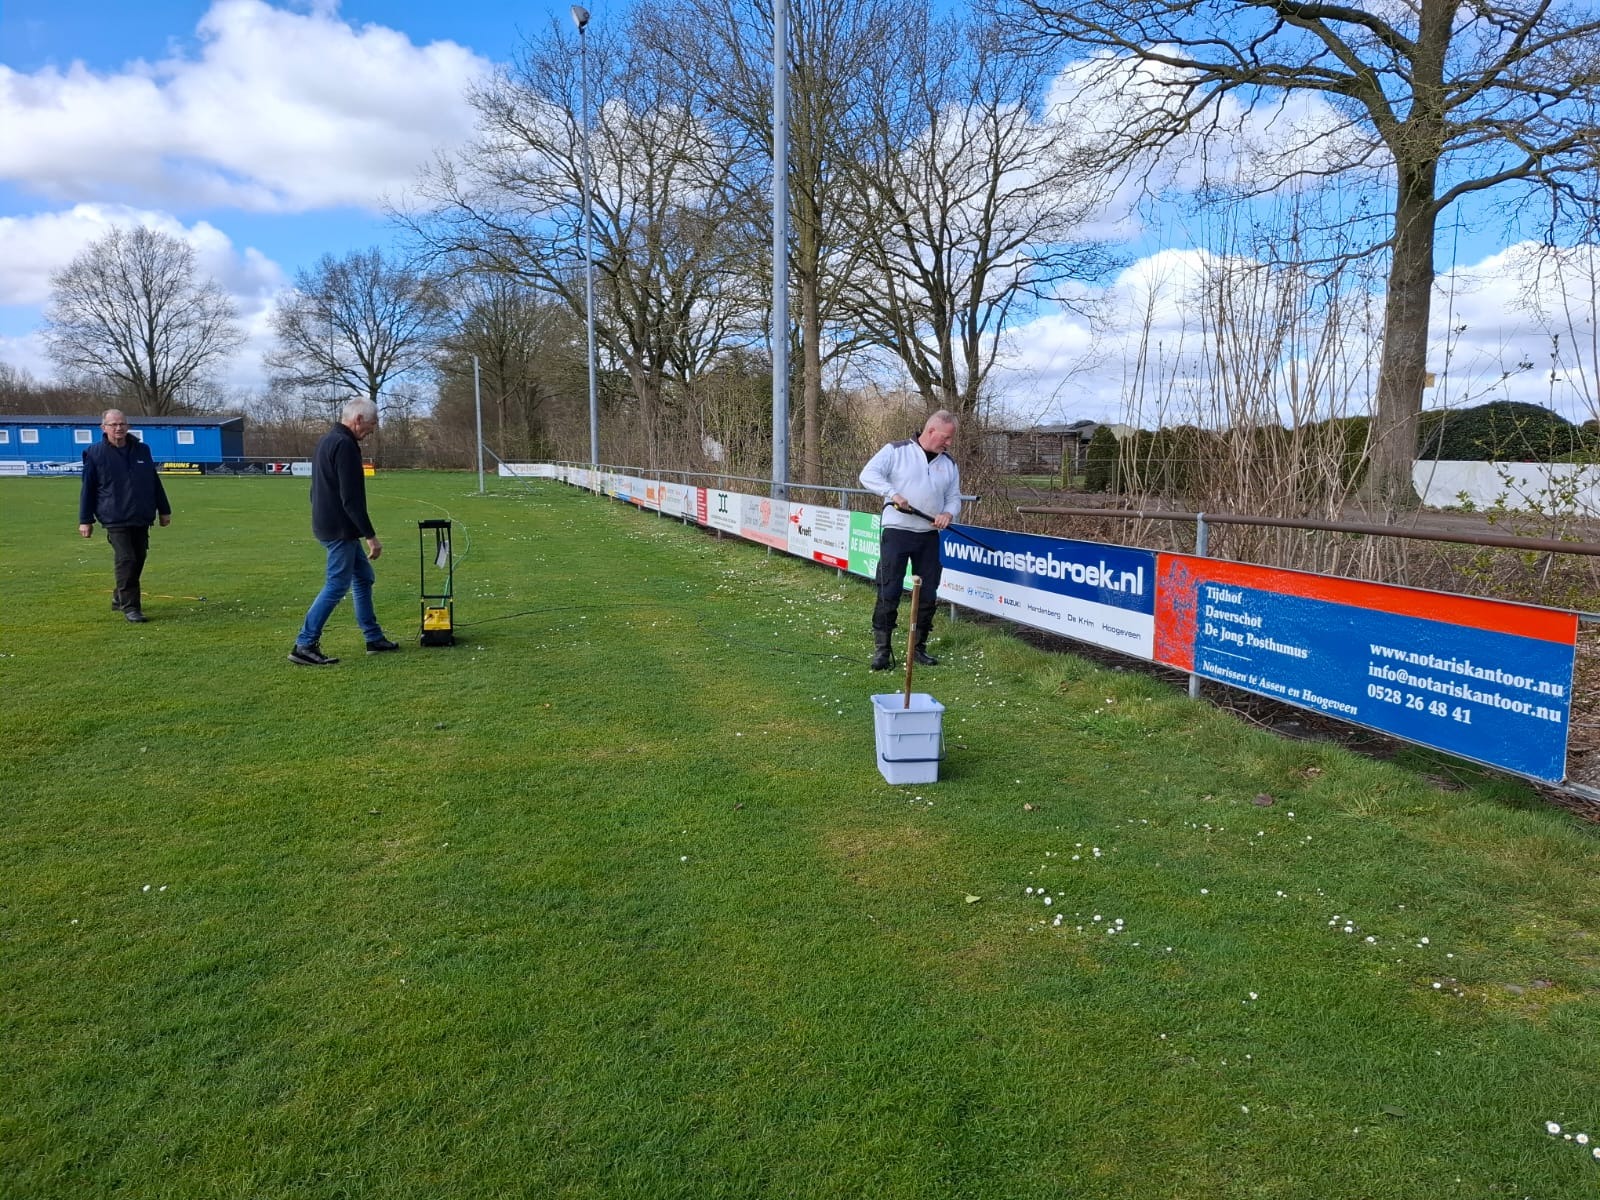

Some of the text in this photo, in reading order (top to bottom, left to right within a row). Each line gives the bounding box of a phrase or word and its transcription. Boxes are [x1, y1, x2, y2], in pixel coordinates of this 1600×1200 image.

[944, 540, 1143, 595] www.mastebroek.nl
[1027, 603, 1061, 620] Hardenberg
[1205, 586, 1243, 604] Tijdhof
[1067, 613, 1094, 628] De Krim
[1102, 622, 1141, 640] Hoogeveen
[1205, 605, 1263, 628] Daverschot
[1204, 622, 1309, 659] De Jong Posthumus
[1202, 660, 1358, 715] Notarissen te Assen en Hoogeveen
[1369, 643, 1564, 697] www.notariskantoor.nu
[1367, 683, 1472, 725] 0528 26 48 41
[1368, 662, 1562, 723] info@notariskantoor.nu
